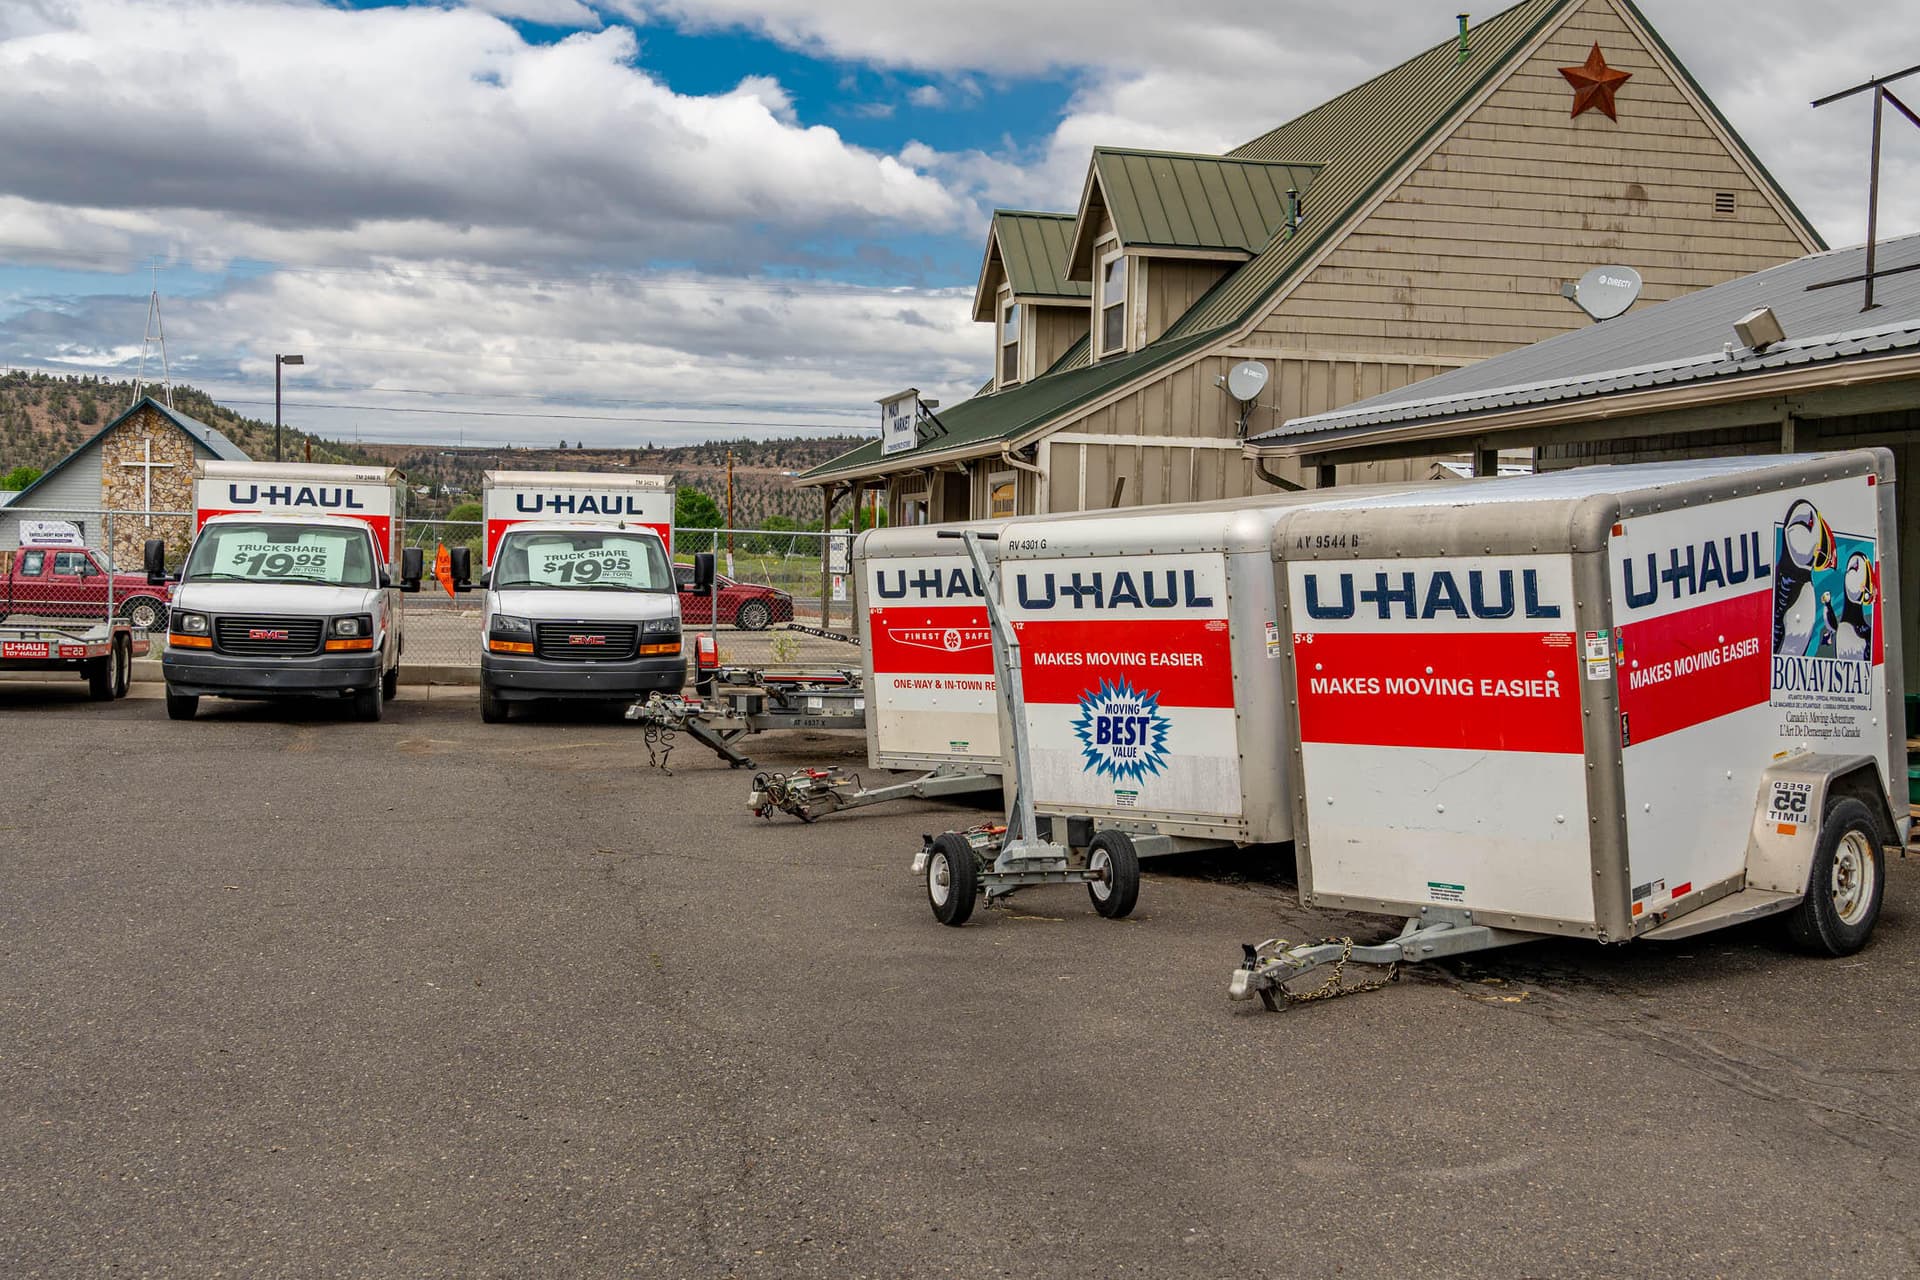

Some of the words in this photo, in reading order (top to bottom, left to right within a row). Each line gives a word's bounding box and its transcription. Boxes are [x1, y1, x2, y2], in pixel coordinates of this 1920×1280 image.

[230, 484, 363, 508] U-HAUL
[516, 494, 643, 515] U-HAUL
[1009, 540, 1020, 550] RV
[1021, 540, 1038, 550] 4301
[1041, 539, 1047, 549] G
[1316, 535, 1346, 548] 9544
[1622, 531, 1770, 609] U-HAUL
[1017, 570, 1213, 609] U-HAUL
[1304, 569, 1560, 620] U-HAUL
[249, 630, 288, 640] GMC
[569, 635, 606, 644] GMC
[1034, 653, 1082, 665] MAKES
[1086, 653, 1146, 666] MOVING
[1150, 653, 1203, 666] EASIER
[1629, 660, 1672, 690] MAKES
[1674, 648, 1720, 678] MOVING
[1722, 638, 1759, 664] EASIER
[1772, 656, 1862, 694] BONAVISTA
[893, 679, 933, 689] ONE-WAY
[935, 680, 941, 688] &
[945, 680, 982, 690] IN-TOWN
[1310, 677, 1380, 695] MAKES
[1386, 678, 1474, 696] MOVING
[1481, 679, 1560, 698] EASIER
[1105, 704, 1140, 715] MOVING
[1786, 711, 1808, 722] Canada's
[1809, 712, 1829, 726] Moving
[1096, 716, 1150, 746] BEST
[1780, 724, 1794, 736] L'Art
[1795, 725, 1802, 736] De
[1833, 726, 1840, 736] Au
[1842, 726, 1860, 737] Canada
[1112, 746, 1136, 758] VALUE
